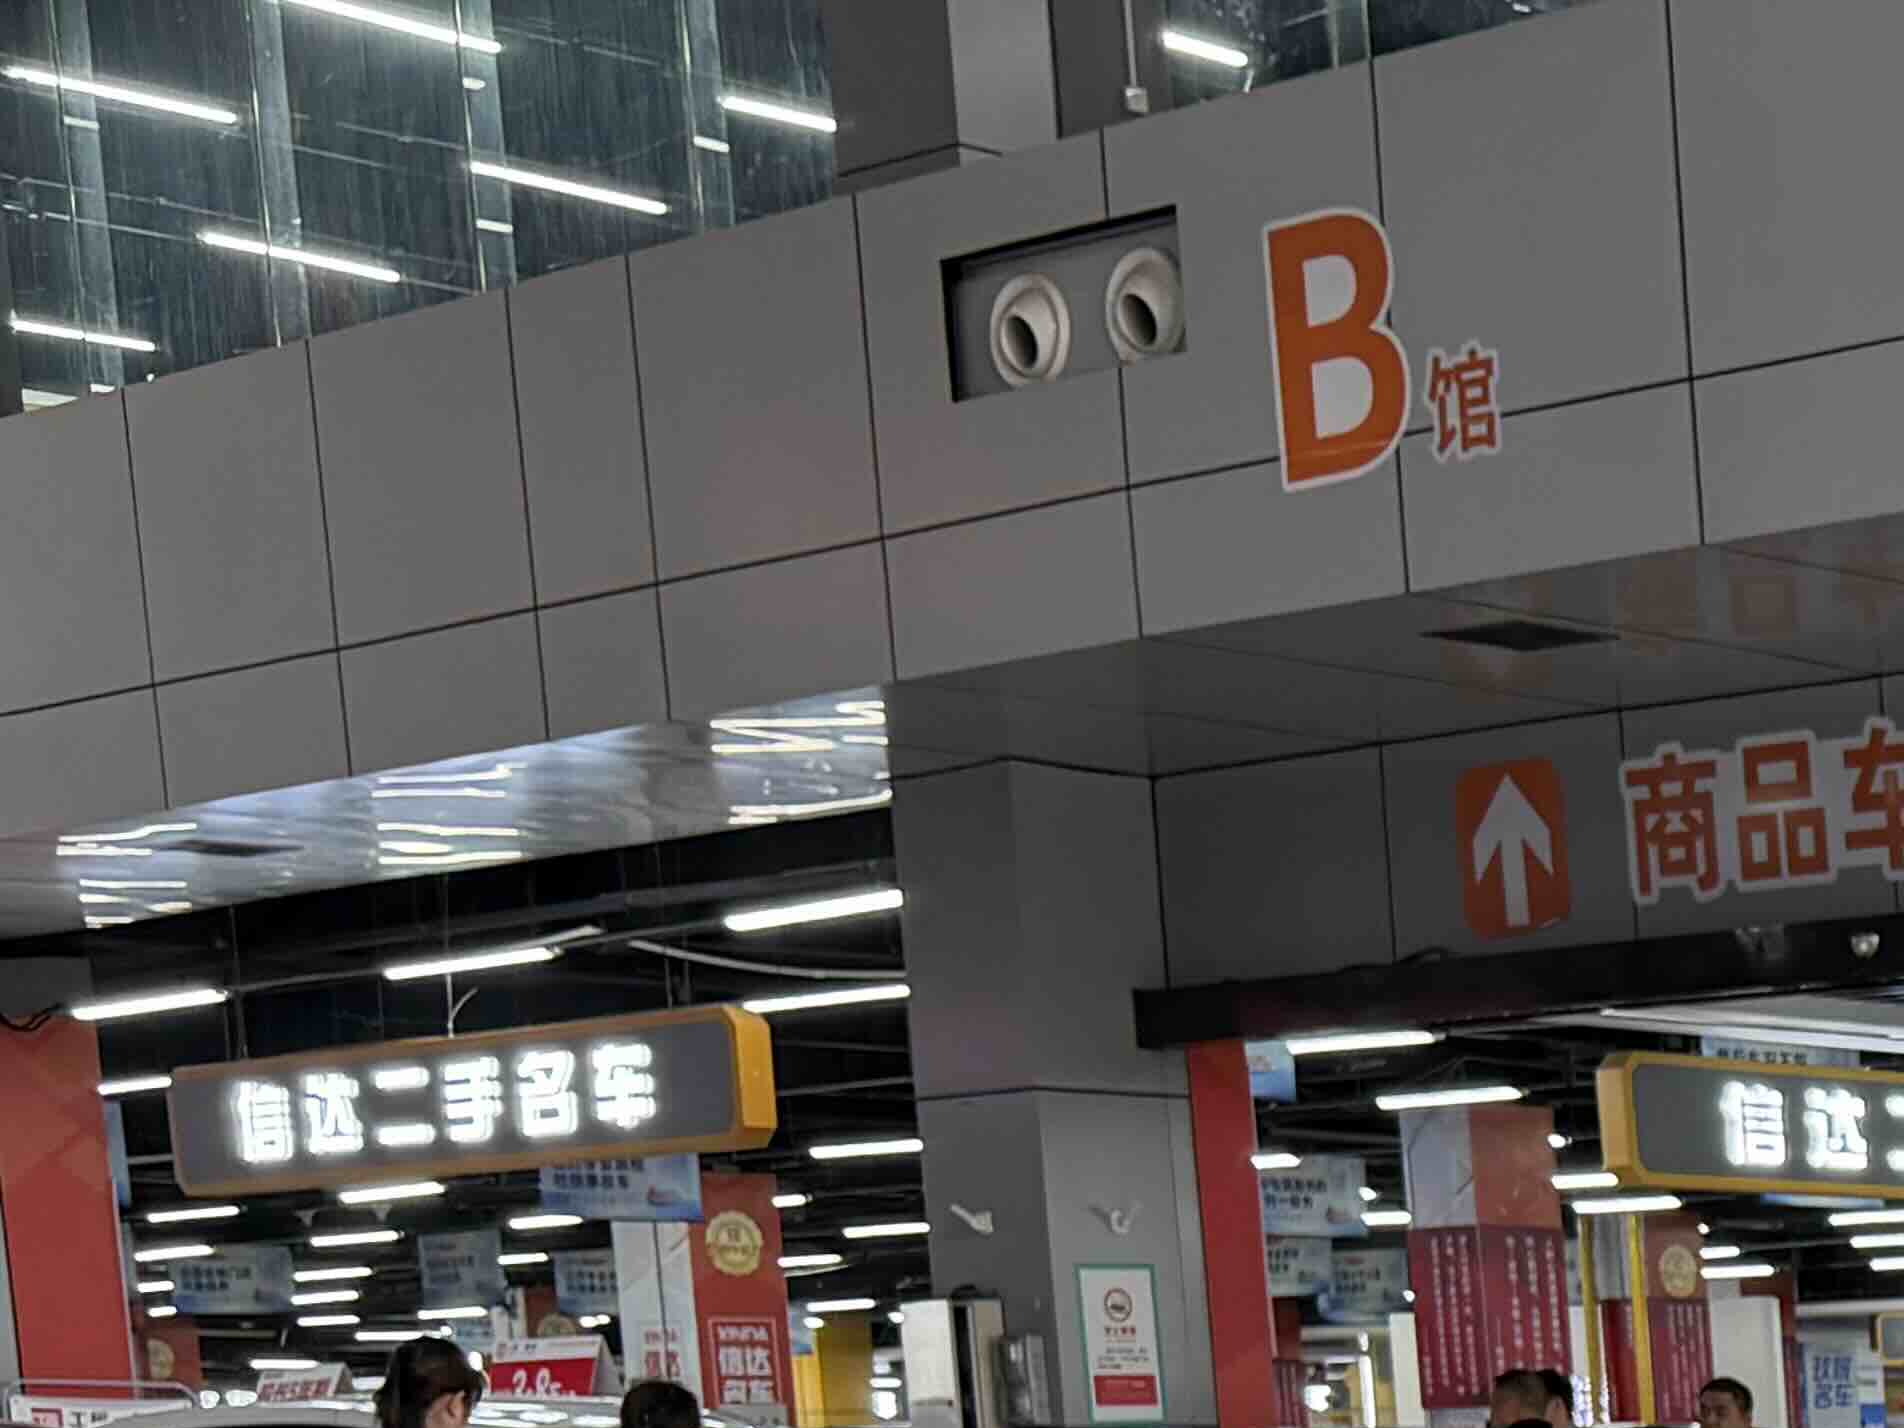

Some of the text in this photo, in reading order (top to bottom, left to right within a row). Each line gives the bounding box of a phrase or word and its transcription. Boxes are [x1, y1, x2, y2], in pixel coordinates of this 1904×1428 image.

[231, 1042, 657, 1165] 信达二手名车
